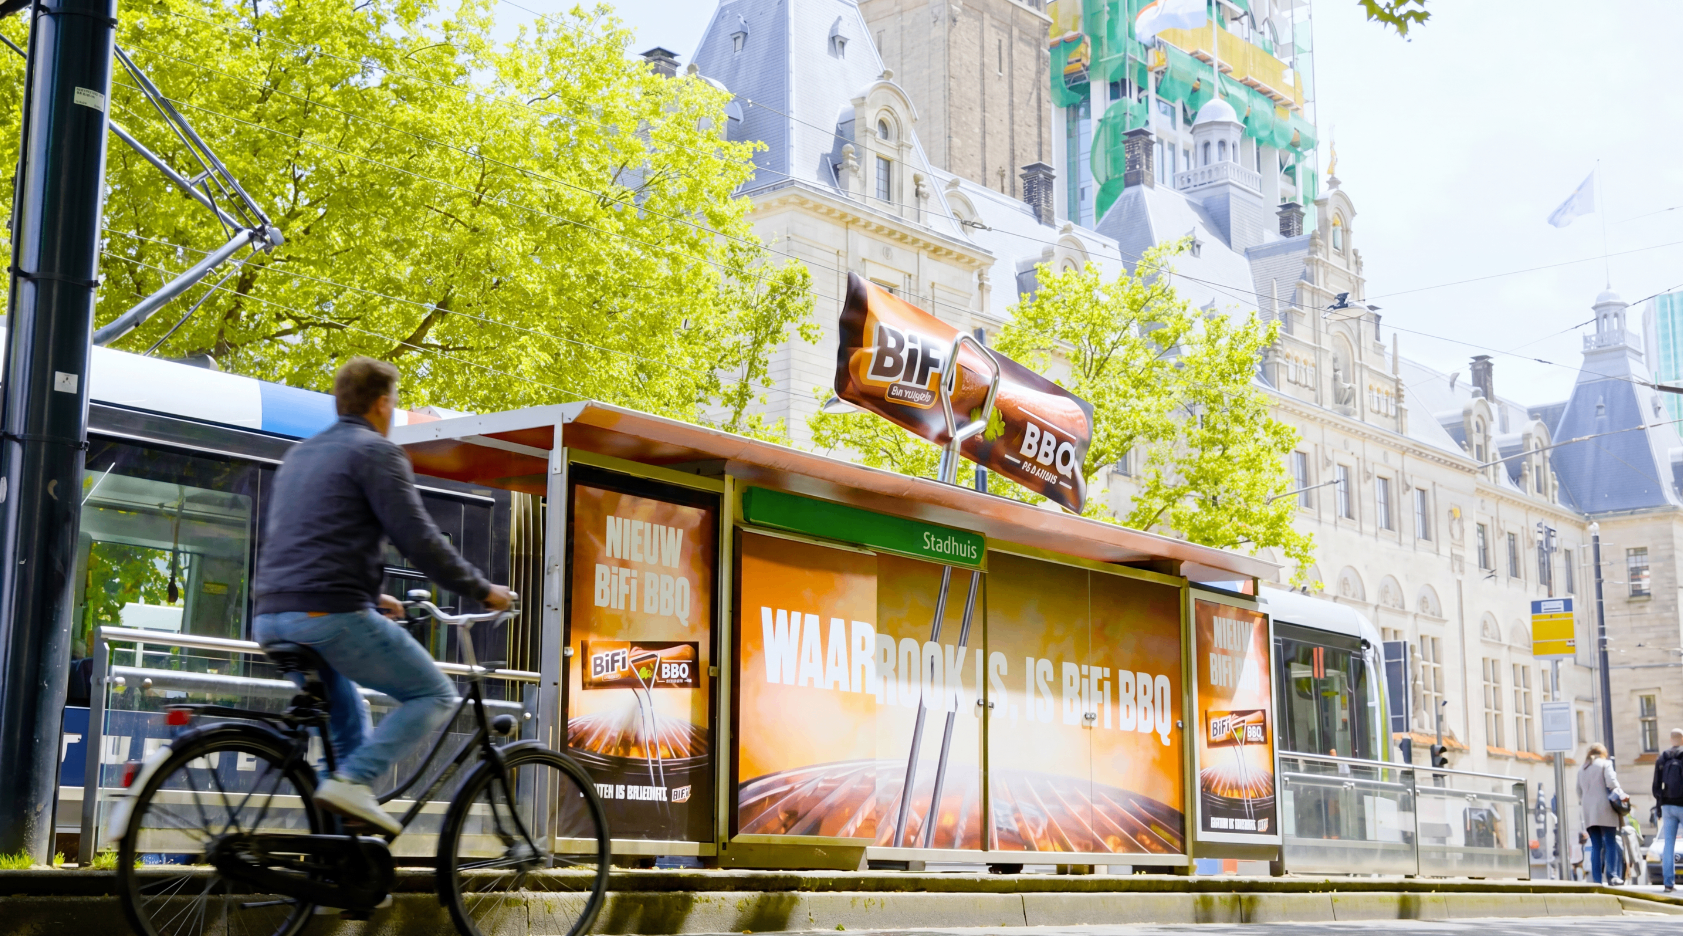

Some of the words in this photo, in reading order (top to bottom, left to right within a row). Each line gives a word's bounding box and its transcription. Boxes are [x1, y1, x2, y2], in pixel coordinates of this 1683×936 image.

[1019, 421, 1075, 480] BBQ
[606, 515, 683, 569] NIEUW
[923, 531, 977, 559] Stadhuis
[594, 563, 638, 612] BiFi
[644, 571, 690, 627] BBQ
[1213, 615, 1255, 654] NIEUW
[592, 649, 628, 678] BiFi
[1026, 656, 1055, 724] IS
[1062, 661, 1112, 730] BiFi
[1119, 669, 1172, 746] BBQ
[1211, 717, 1231, 738] BiFi
